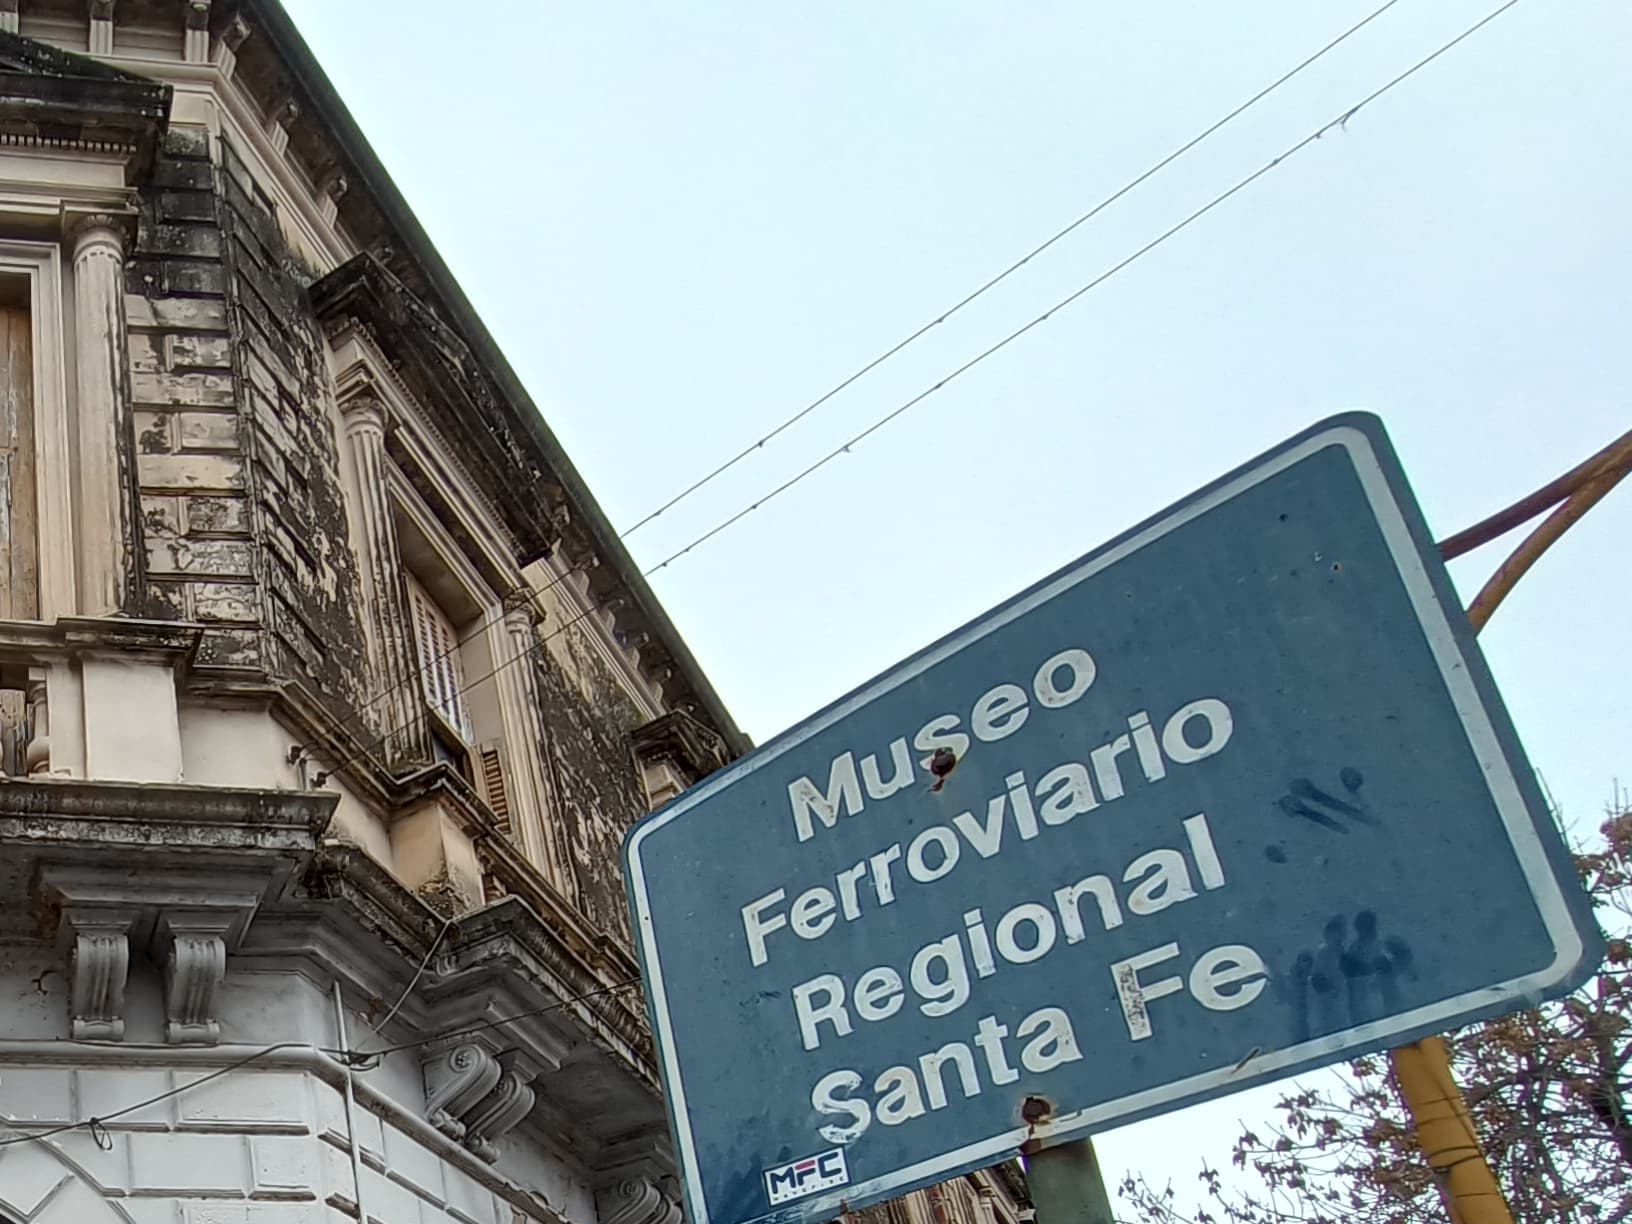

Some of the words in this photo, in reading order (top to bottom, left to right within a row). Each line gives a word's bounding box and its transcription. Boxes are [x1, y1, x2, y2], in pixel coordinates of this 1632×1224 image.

[742, 699, 1233, 967] Ferroviario
[788, 649, 1096, 842] Museo
[793, 814, 1225, 1050] Regional
[812, 1008, 1084, 1144] Santa
[1111, 942, 1267, 1041] Fe
[770, 1152, 842, 1195] MFC
